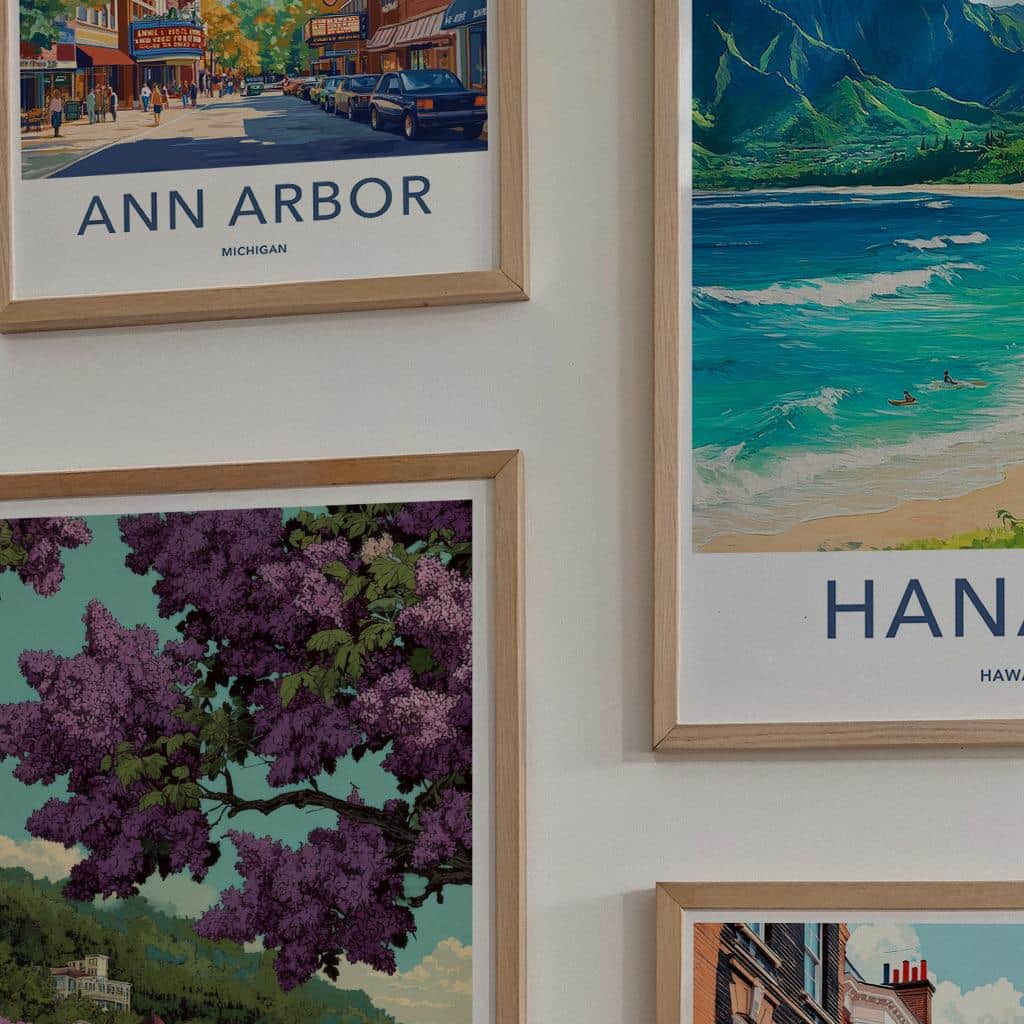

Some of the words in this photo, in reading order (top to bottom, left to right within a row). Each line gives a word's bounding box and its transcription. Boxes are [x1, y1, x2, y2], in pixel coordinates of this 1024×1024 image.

[77, 188, 204, 236] ANN
[228, 175, 432, 227] ARBOR
[221, 244, 288, 257] MICHIGAN
[826, 577, 1024, 639] HAN
[980, 668, 1024, 682] HAW
